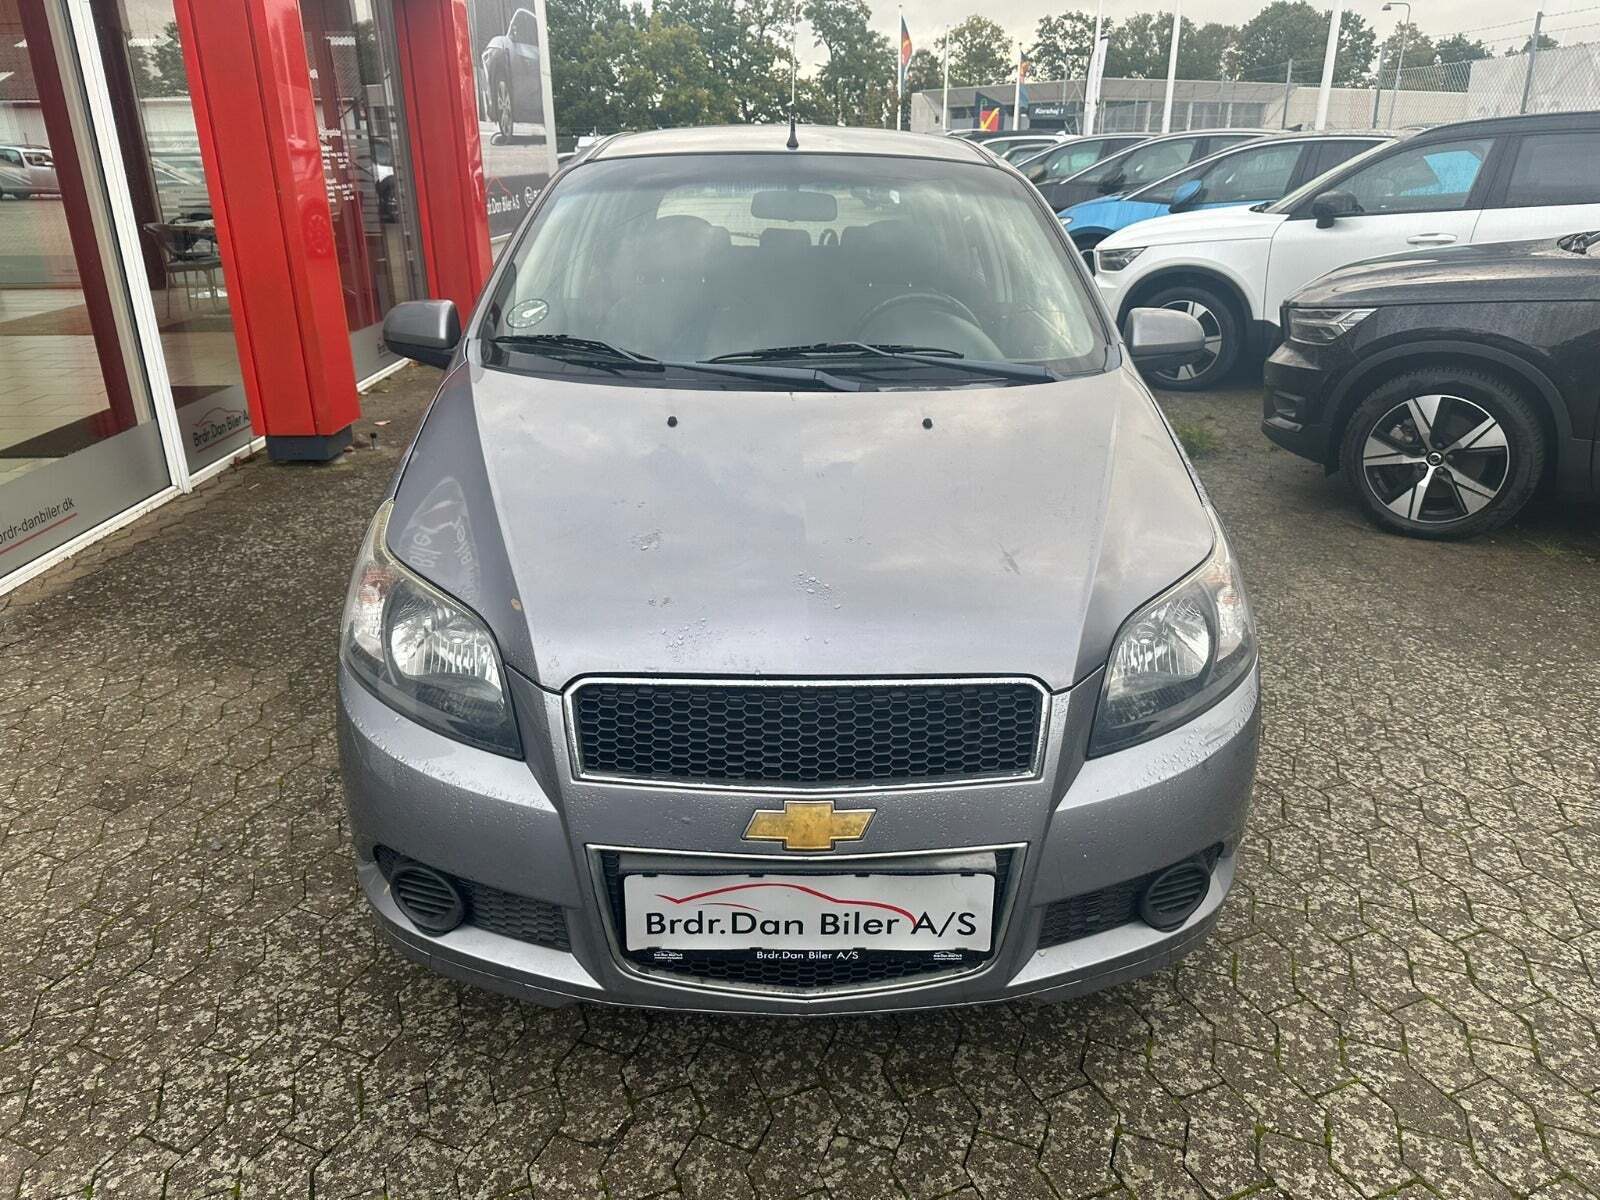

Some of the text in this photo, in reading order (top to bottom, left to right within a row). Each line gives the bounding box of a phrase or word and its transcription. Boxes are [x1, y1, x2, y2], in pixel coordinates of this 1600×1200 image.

[193, 422, 227, 447] Brdr.Dan
[226, 414, 242, 431] Biler
[646, 911, 977, 937] Brdr.Dan Biler A/S
[756, 951, 859, 960] Brdr.Dan Biler A/S
